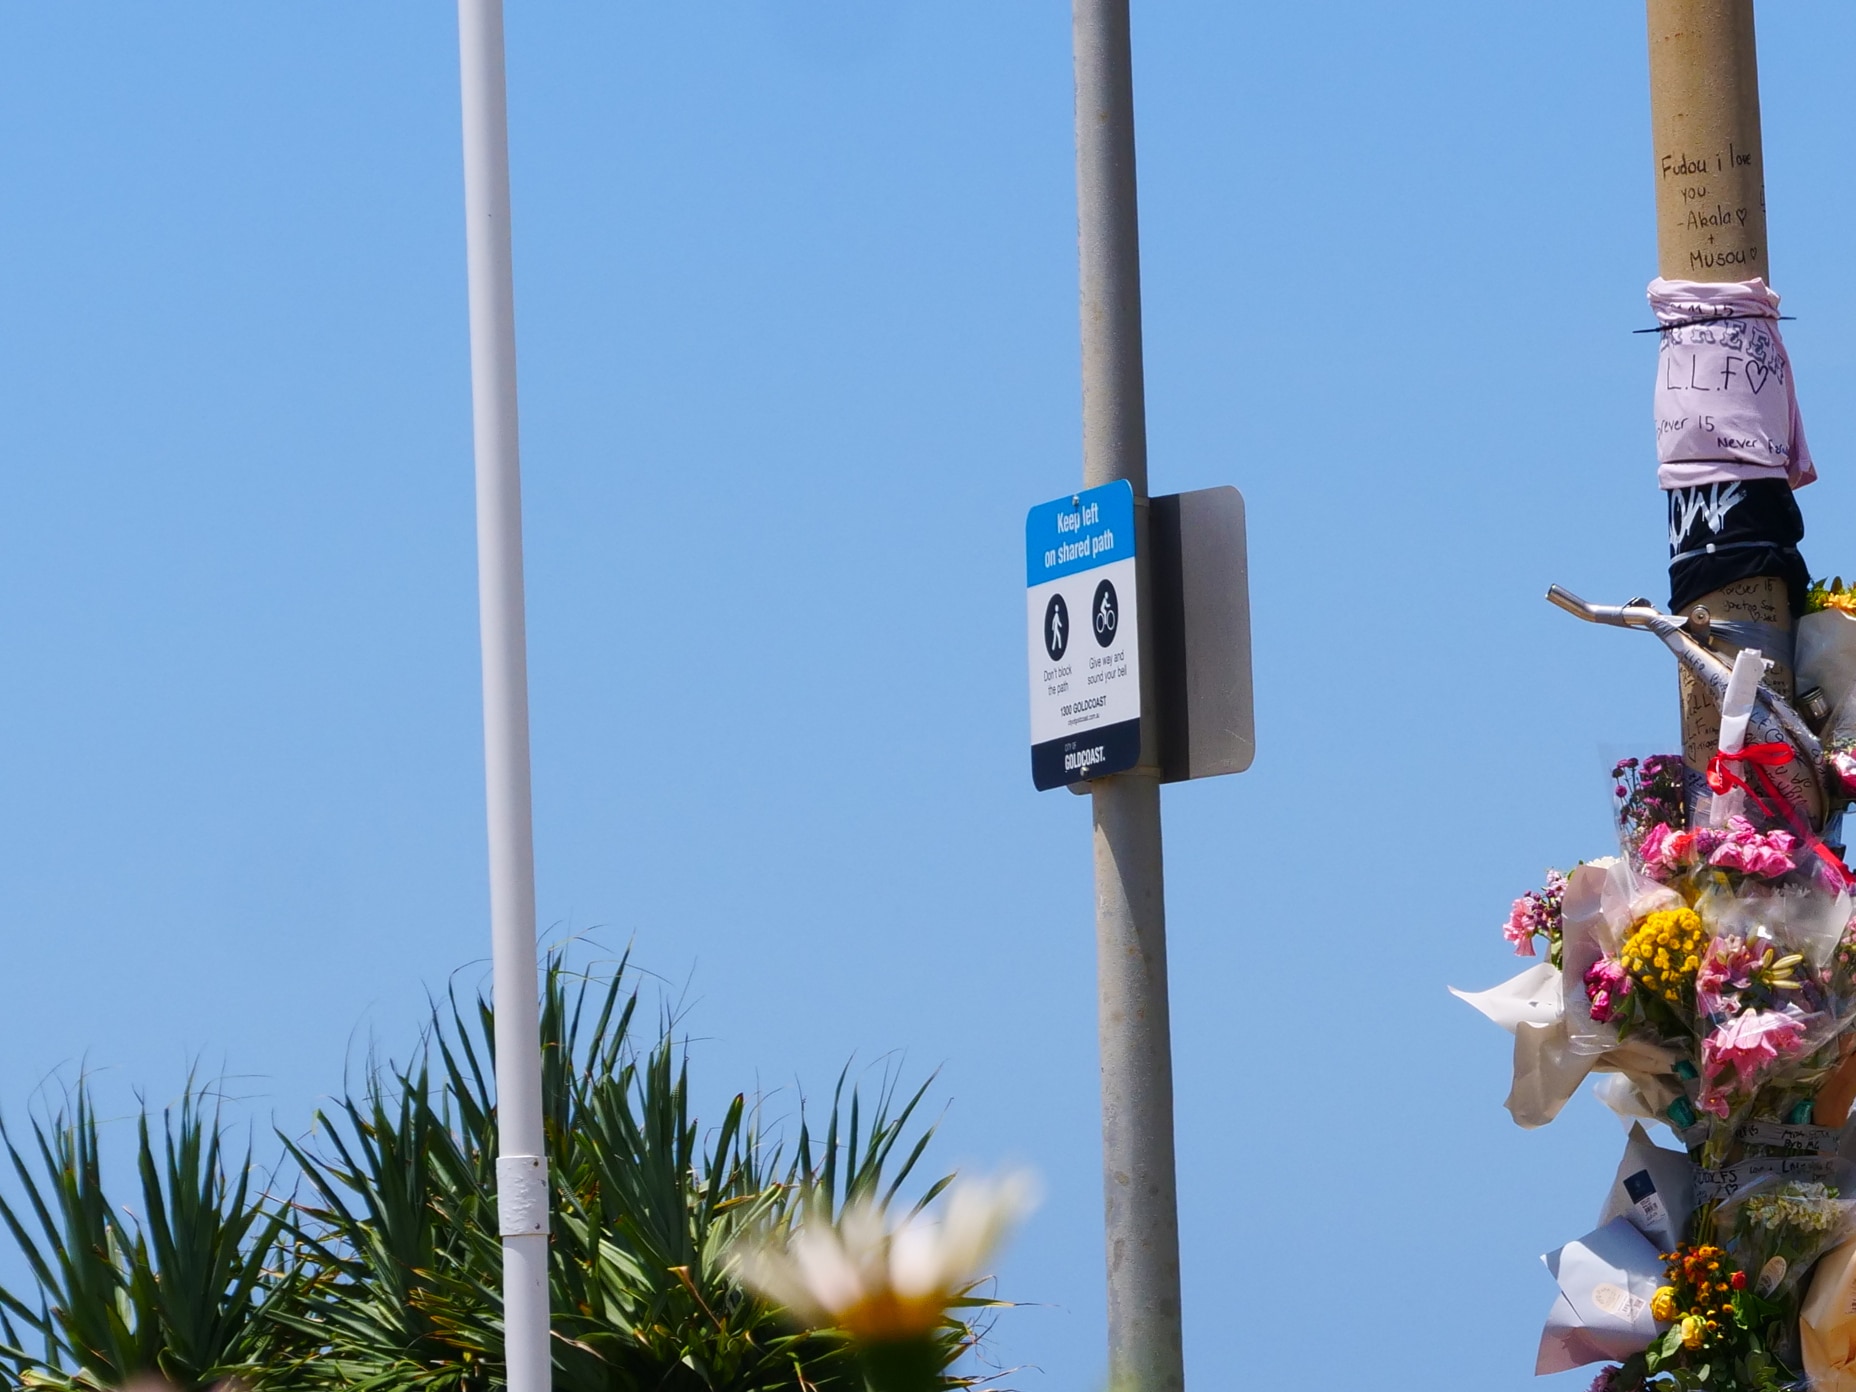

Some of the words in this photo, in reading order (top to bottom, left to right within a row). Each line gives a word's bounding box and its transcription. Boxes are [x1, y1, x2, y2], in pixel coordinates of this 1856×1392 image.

[1729, 143, 1751, 168] love
[1698, 415, 1715, 432] 15
[1056, 511, 1081, 534] Keep
[1082, 502, 1100, 527] left
[1044, 549, 1057, 568] on
[1057, 534, 1091, 564] shared
[1091, 528, 1115, 559] path
[1088, 657, 1102, 670] Give
[1102, 655, 1114, 667] way
[1113, 650, 1125, 663] and
[1058, 665, 1073, 679] block
[1087, 673, 1104, 686] sound
[1104, 670, 1117, 684] your
[1117, 664, 1128, 678] bell
[1057, 682, 1069, 697] path
[1060, 704, 1072, 717] 1300
[1072, 695, 1107, 714] GOLDCOAST
